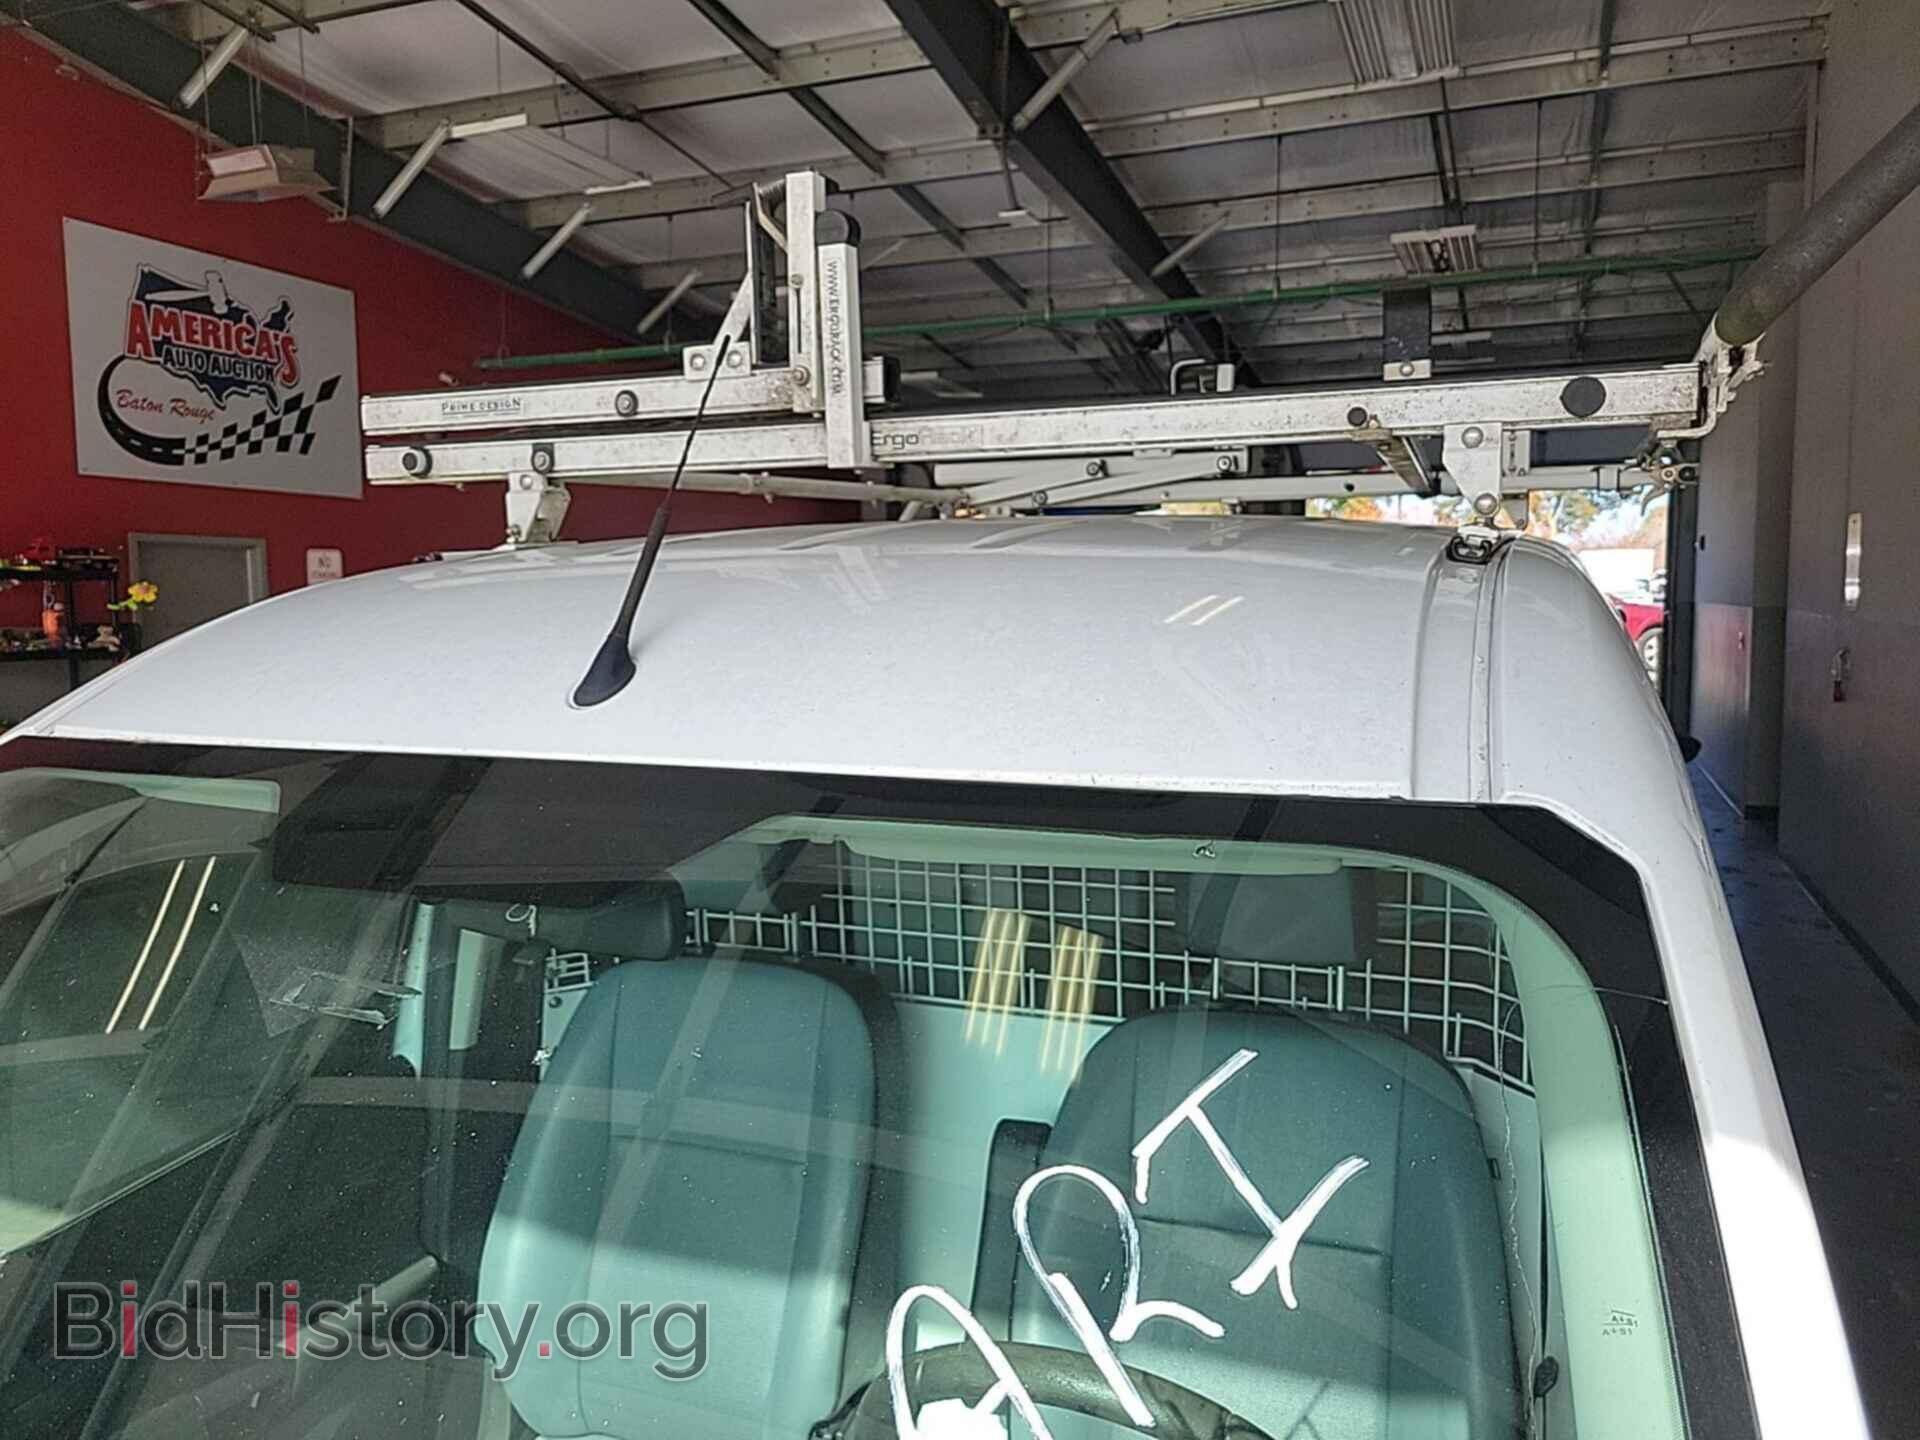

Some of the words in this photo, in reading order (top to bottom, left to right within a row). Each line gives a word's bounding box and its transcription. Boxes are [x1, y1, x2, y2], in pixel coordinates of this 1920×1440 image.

[127, 299, 298, 385] AMERICA'S
[162, 346, 206, 374] AUTO
[211, 356, 275, 383] AUCTION
[115, 388, 163, 413] Baton
[169, 398, 215, 424] Rouge
